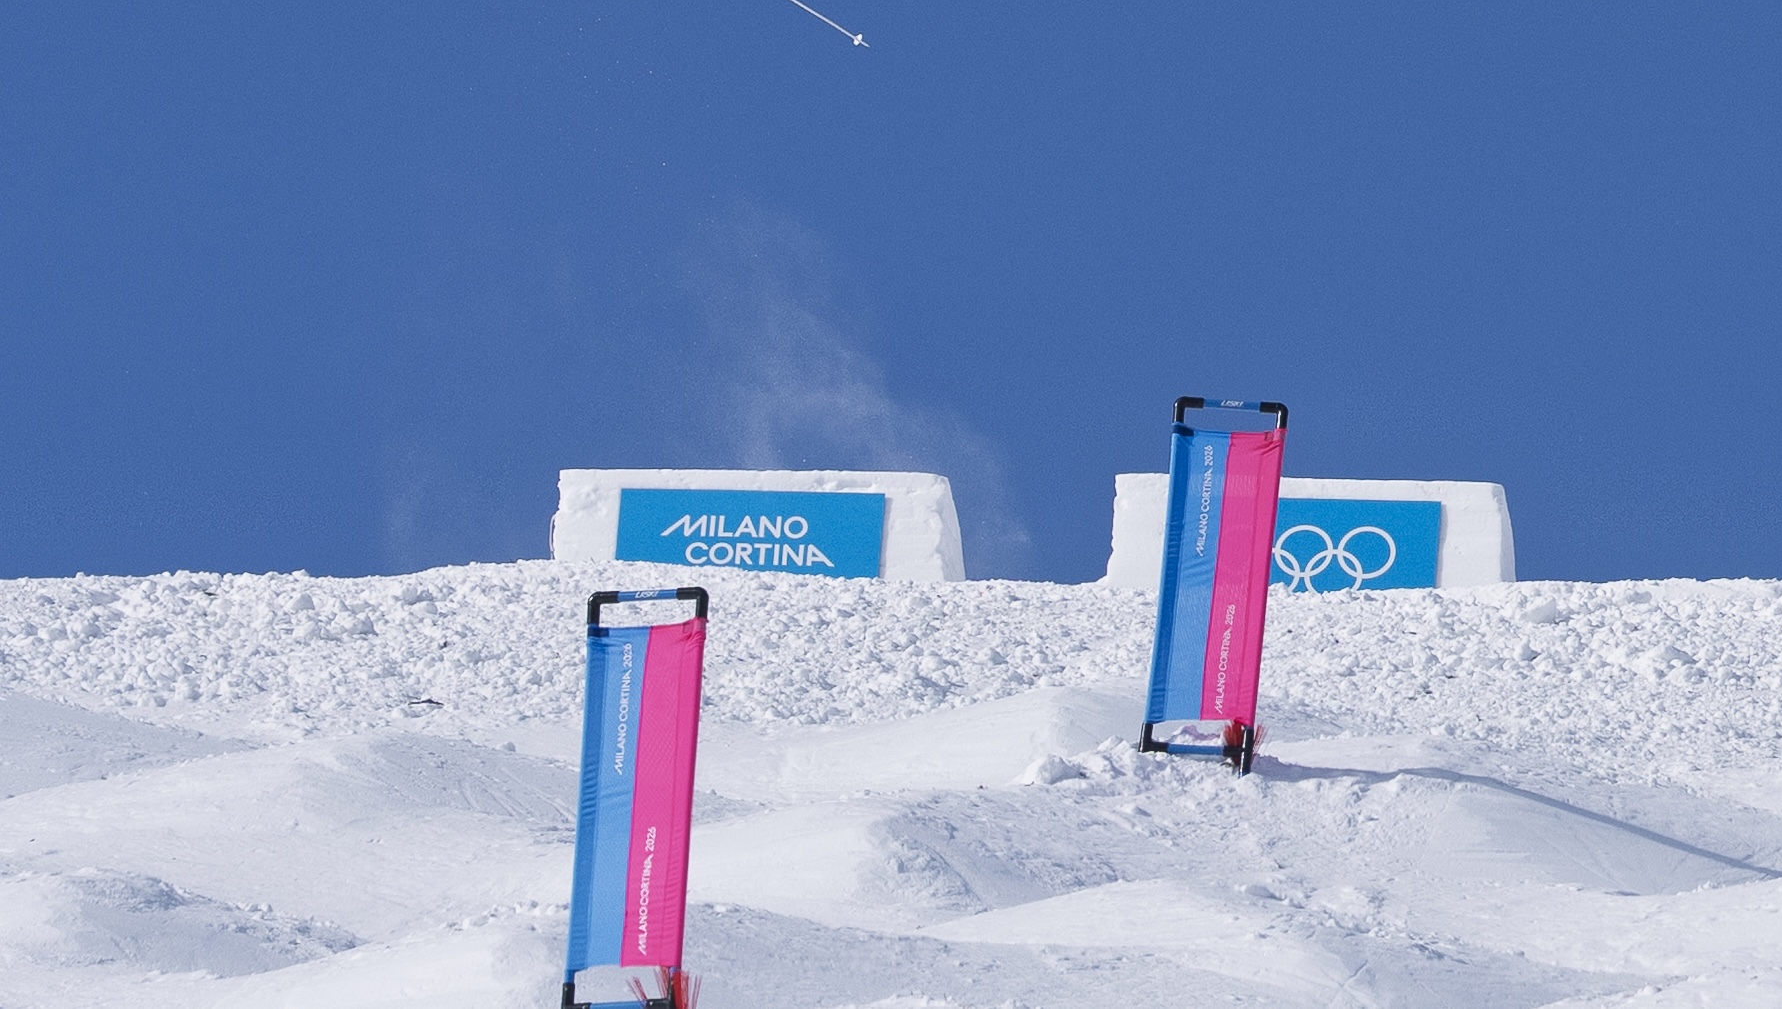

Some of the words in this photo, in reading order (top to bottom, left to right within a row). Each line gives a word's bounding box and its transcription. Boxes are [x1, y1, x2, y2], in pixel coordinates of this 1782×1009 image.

[1204, 445, 1213, 466] 2026
[1200, 467, 1213, 512] CORTINA
[660, 514, 808, 539] MILANO
[1195, 512, 1209, 557] MILANO
[685, 541, 835, 567] CORTINA
[1225, 604, 1236, 626] 2026
[623, 643, 632, 668] 2026
[1219, 626, 1233, 671] CORTINA
[619, 669, 632, 722] CORTINA
[1214, 672, 1226, 715] MILANO
[614, 723, 627, 775] MILANO
[645, 826, 656, 852] 2026
[640, 853, 654, 906] CORTINA
[638, 907, 648, 955] MILANO
